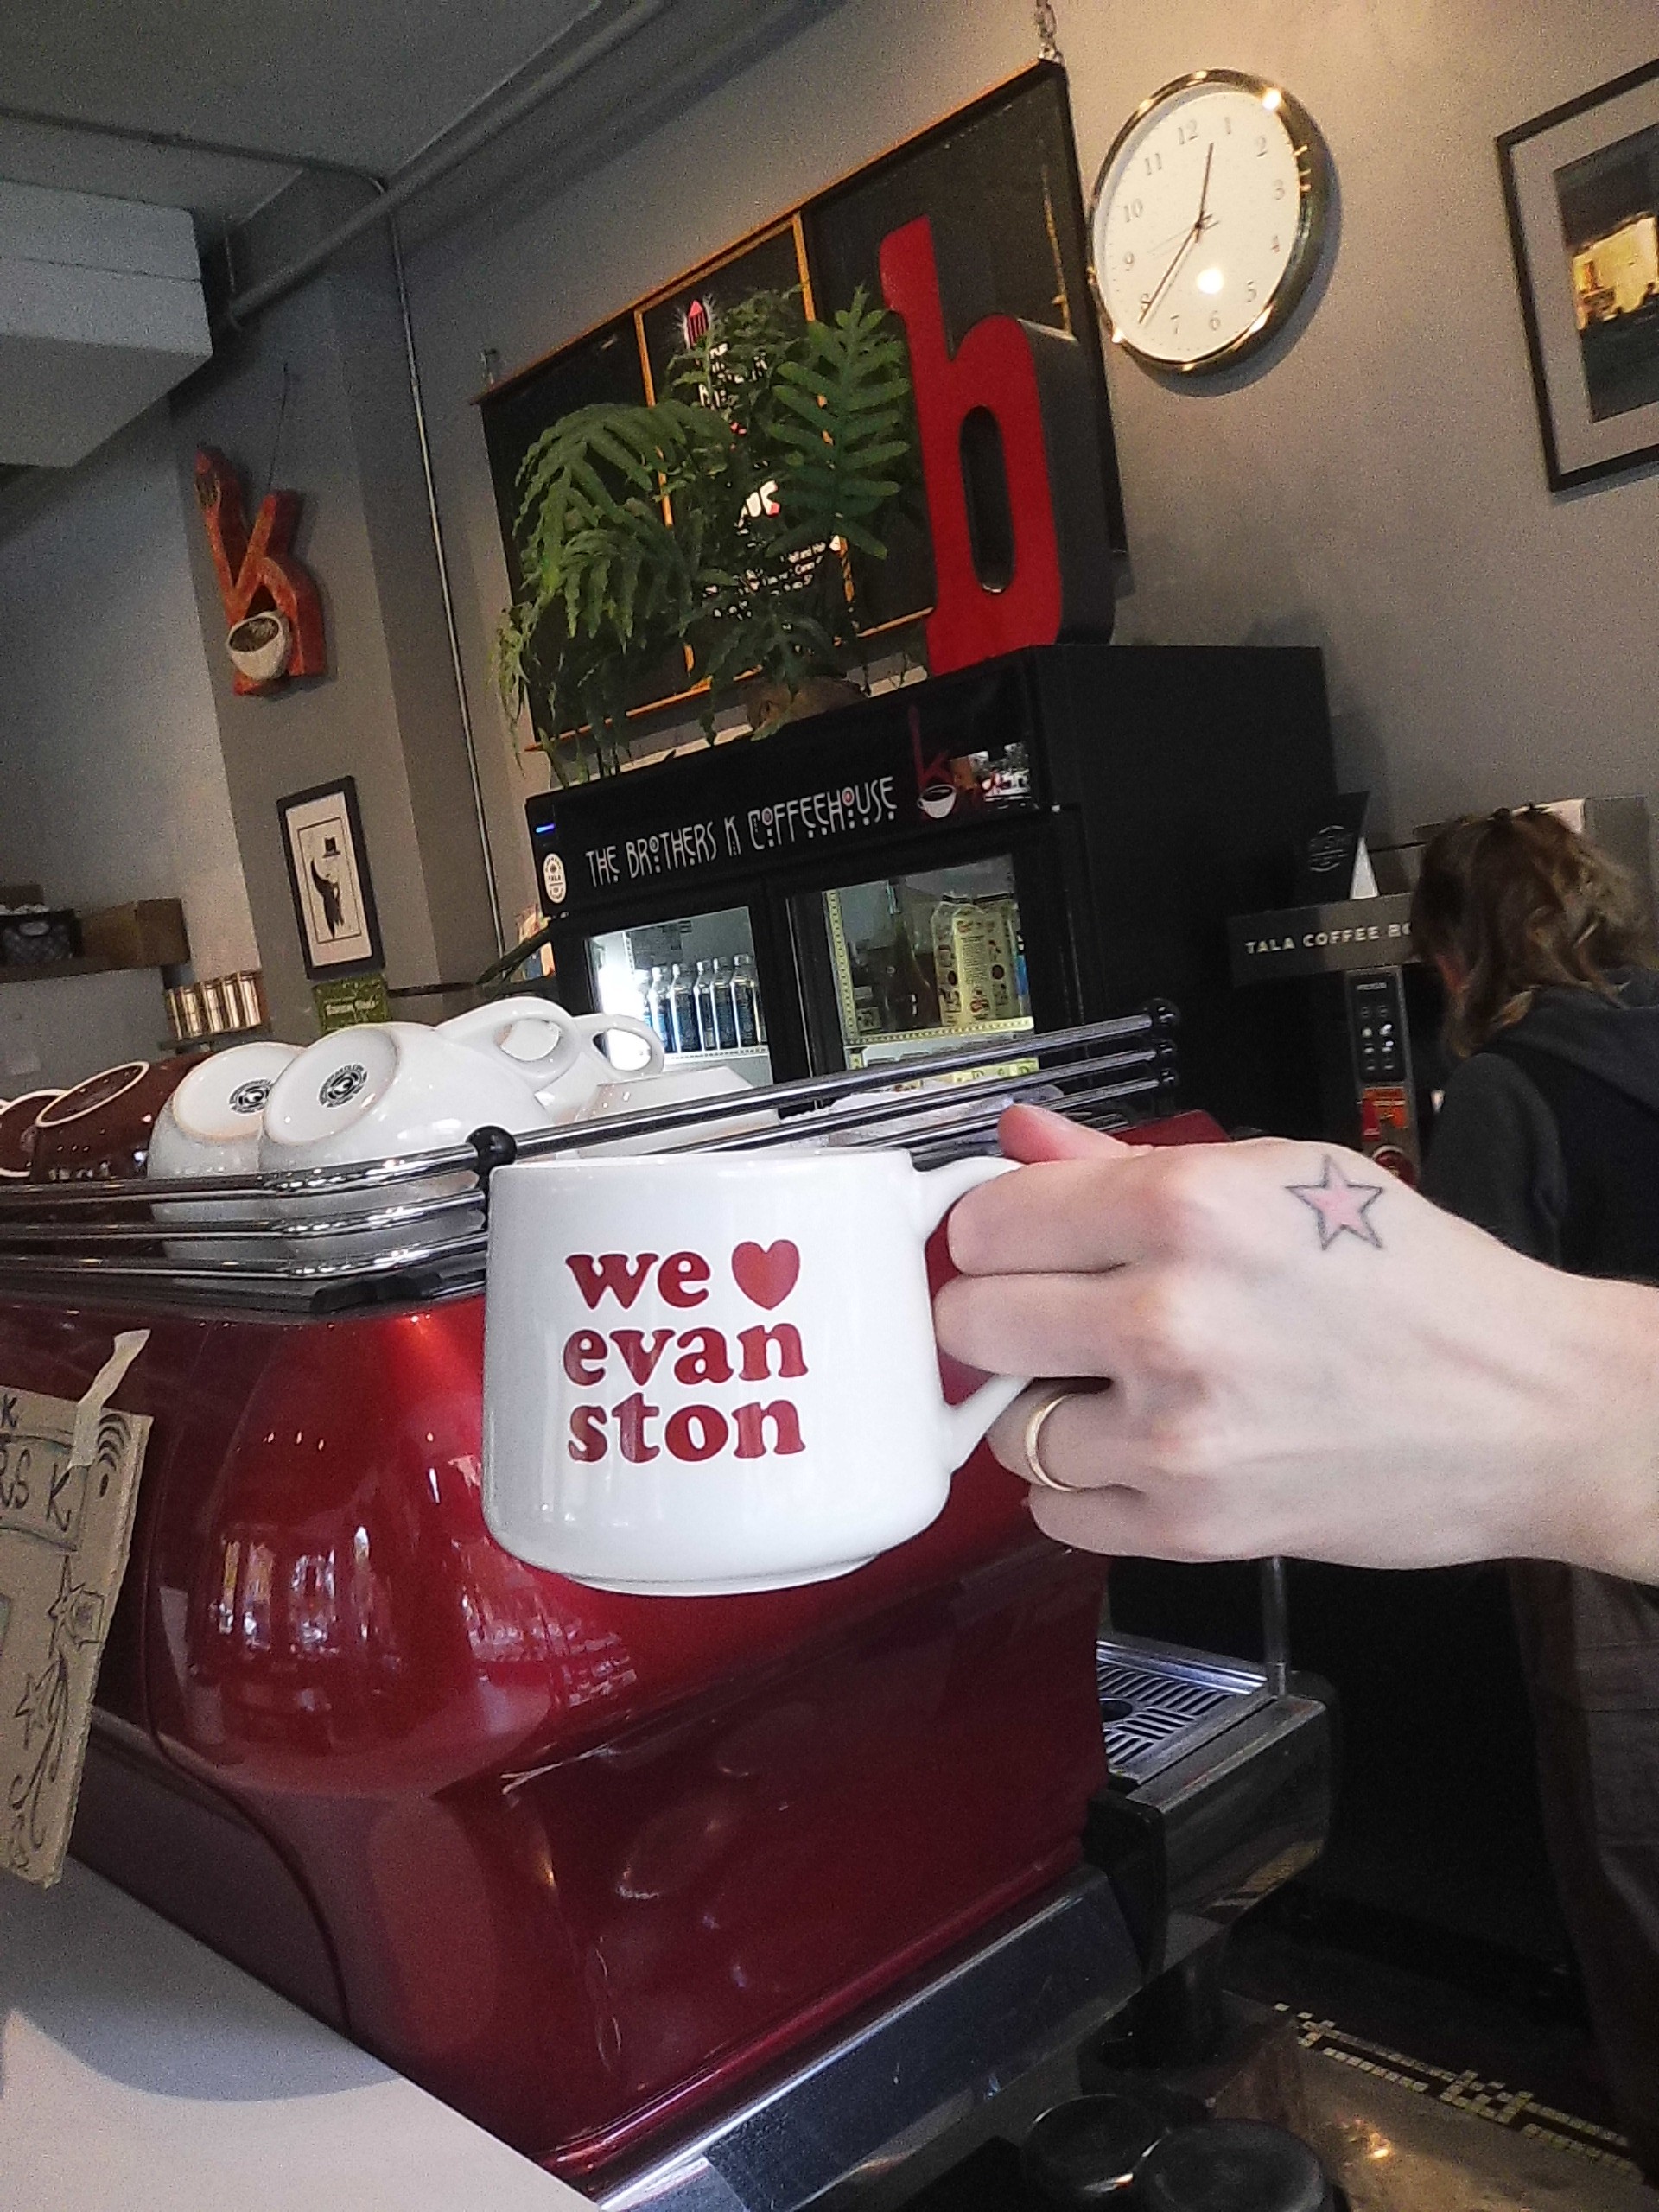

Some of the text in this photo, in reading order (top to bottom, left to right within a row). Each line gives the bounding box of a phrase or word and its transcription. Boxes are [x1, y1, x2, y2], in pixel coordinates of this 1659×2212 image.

[1176, 119, 1198, 146] 12
[1255, 135, 1268, 157] 2
[1143, 152, 1164, 176] 11
[1272, 179, 1286, 201] 3
[1122, 198, 1144, 224] 10
[1269, 234, 1281, 254] 4
[1122, 251, 1135, 272] 9
[1247, 280, 1258, 303] 5
[1170, 313, 1180, 335] 7
[1209, 309, 1222, 332] 6
[585, 776, 898, 887] THE BROTHERS K COFFEEHOUSE
[1244, 937, 1295, 955] TALA
[1302, 925, 1380, 948] COFFEE
[564, 1250, 712, 1310] we
[563, 1322, 810, 1387] evan
[568, 1391, 806, 1464] ston
